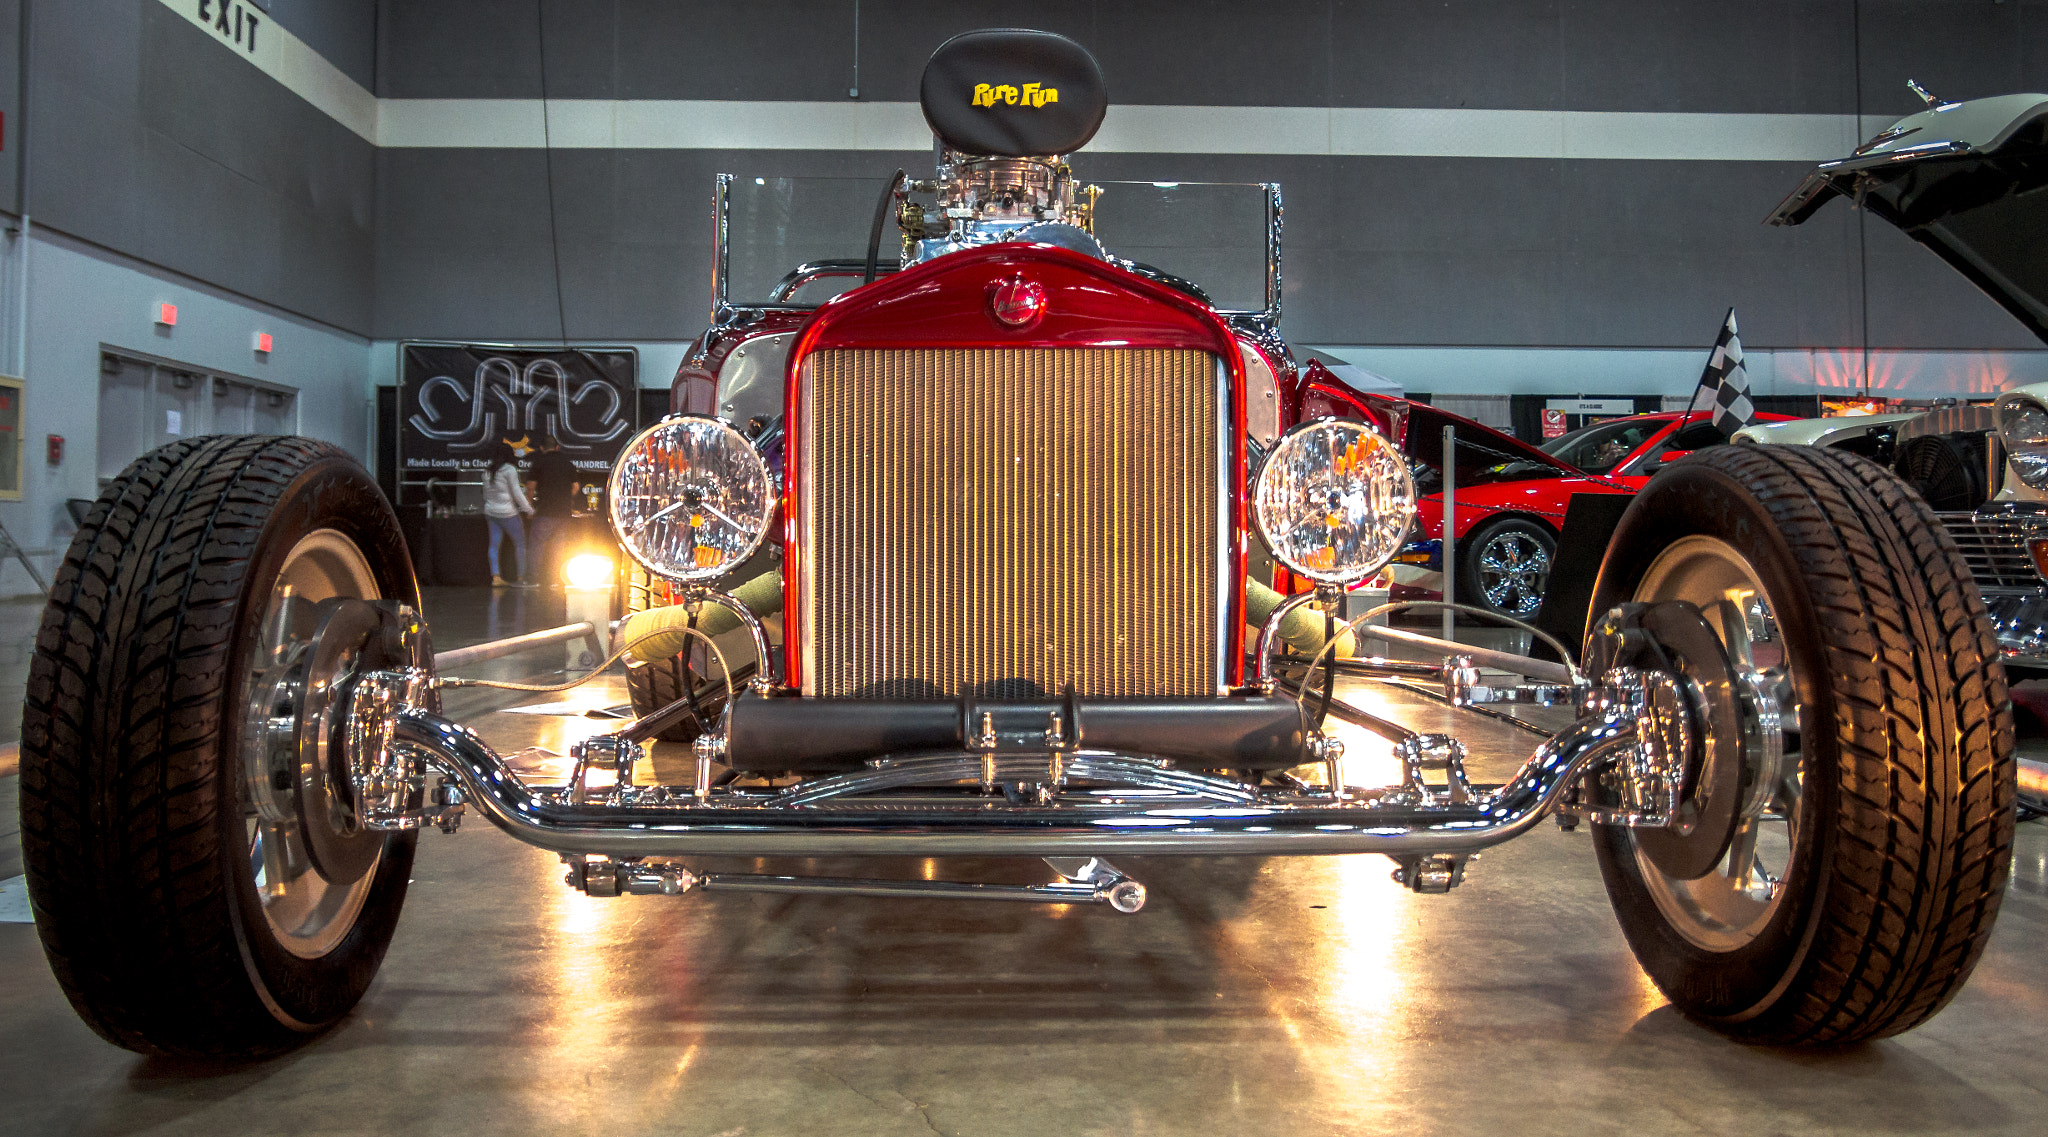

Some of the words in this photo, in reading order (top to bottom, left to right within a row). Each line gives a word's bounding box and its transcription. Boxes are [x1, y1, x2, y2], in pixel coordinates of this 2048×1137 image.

[971, 83, 1018, 108] Pure
[1020, 81, 1059, 108] Fun
[407, 458, 429, 467] Made
[431, 458, 459, 469] Locally
[462, 458, 470, 467] in
